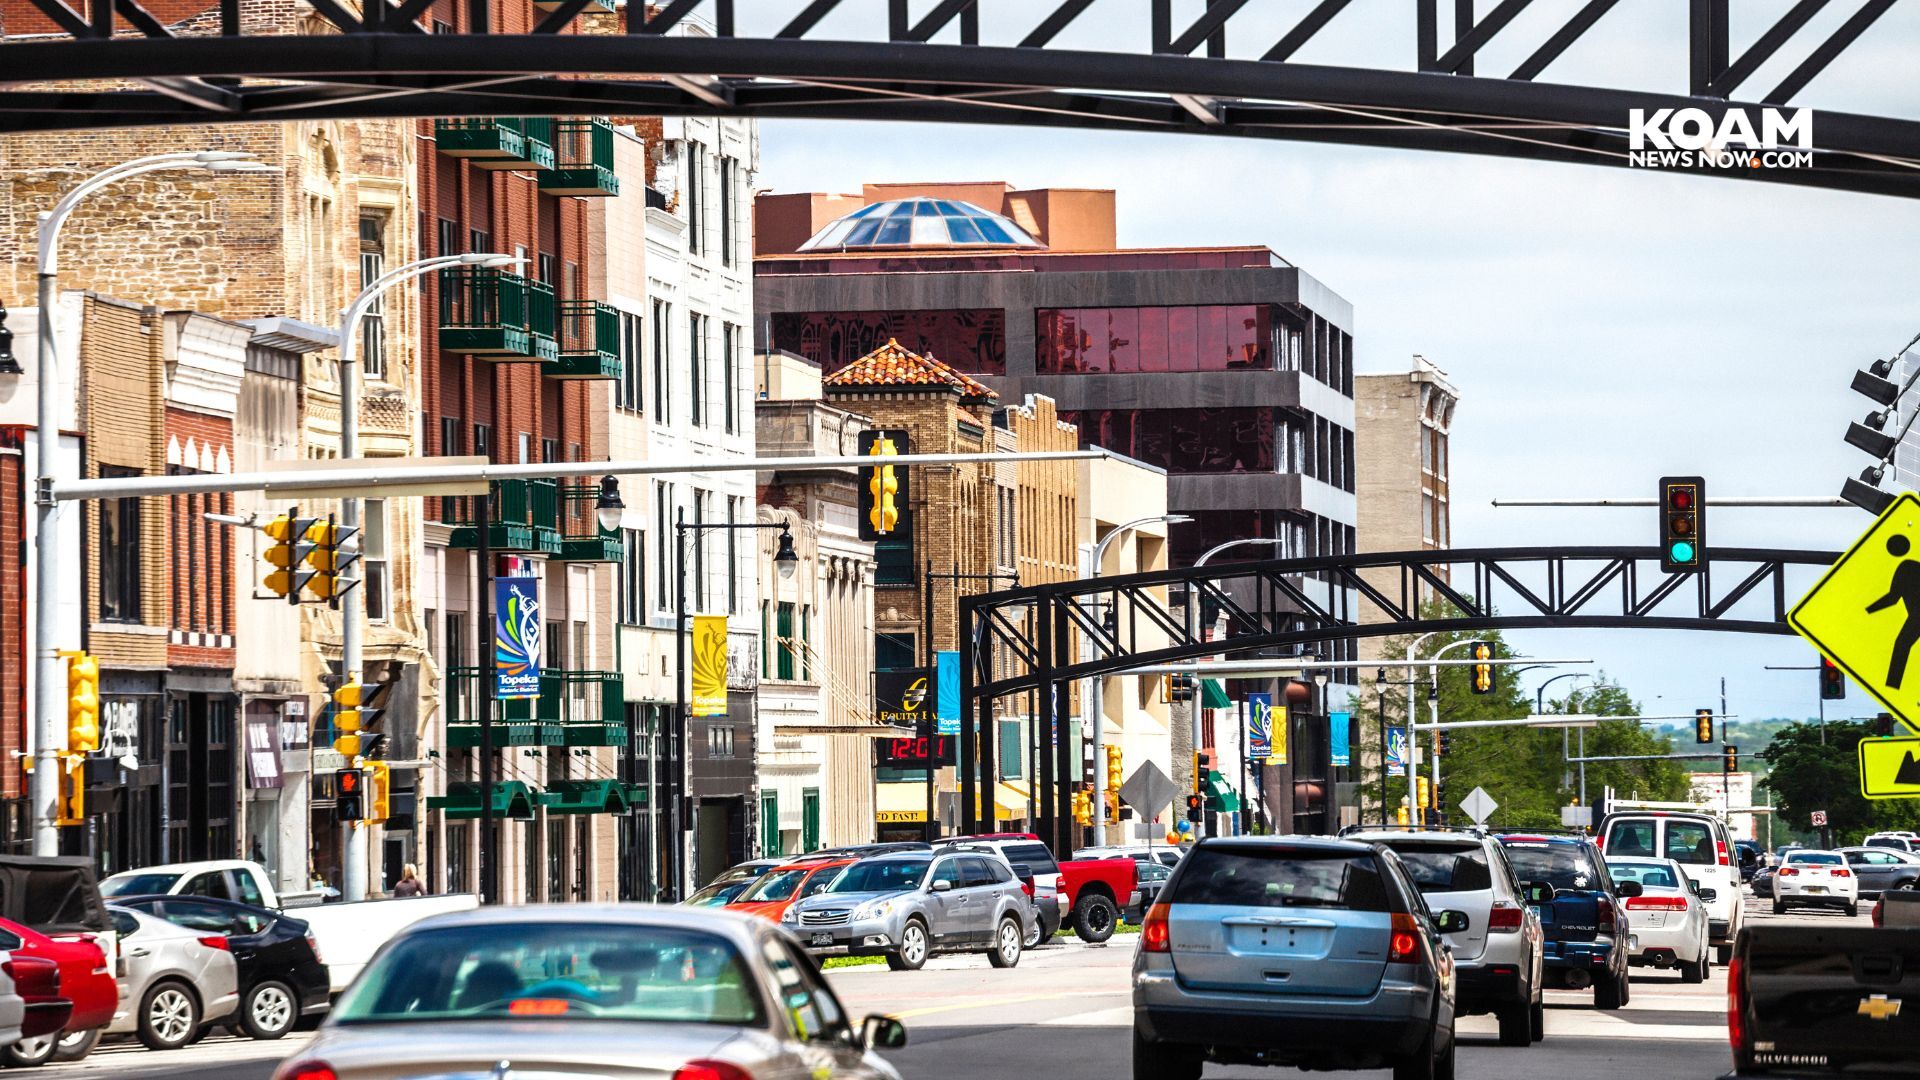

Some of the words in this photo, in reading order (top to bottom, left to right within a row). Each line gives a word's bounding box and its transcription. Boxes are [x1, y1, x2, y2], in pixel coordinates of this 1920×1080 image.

[499, 674, 538, 686] Topeka
[880, 711, 919, 721] EQUITY
[939, 718, 960, 727] Topek
[1250, 744, 1271, 752] Topeka
[892, 812, 918, 821] FAST!
[1753, 1054, 1828, 1065] SILVERADO
